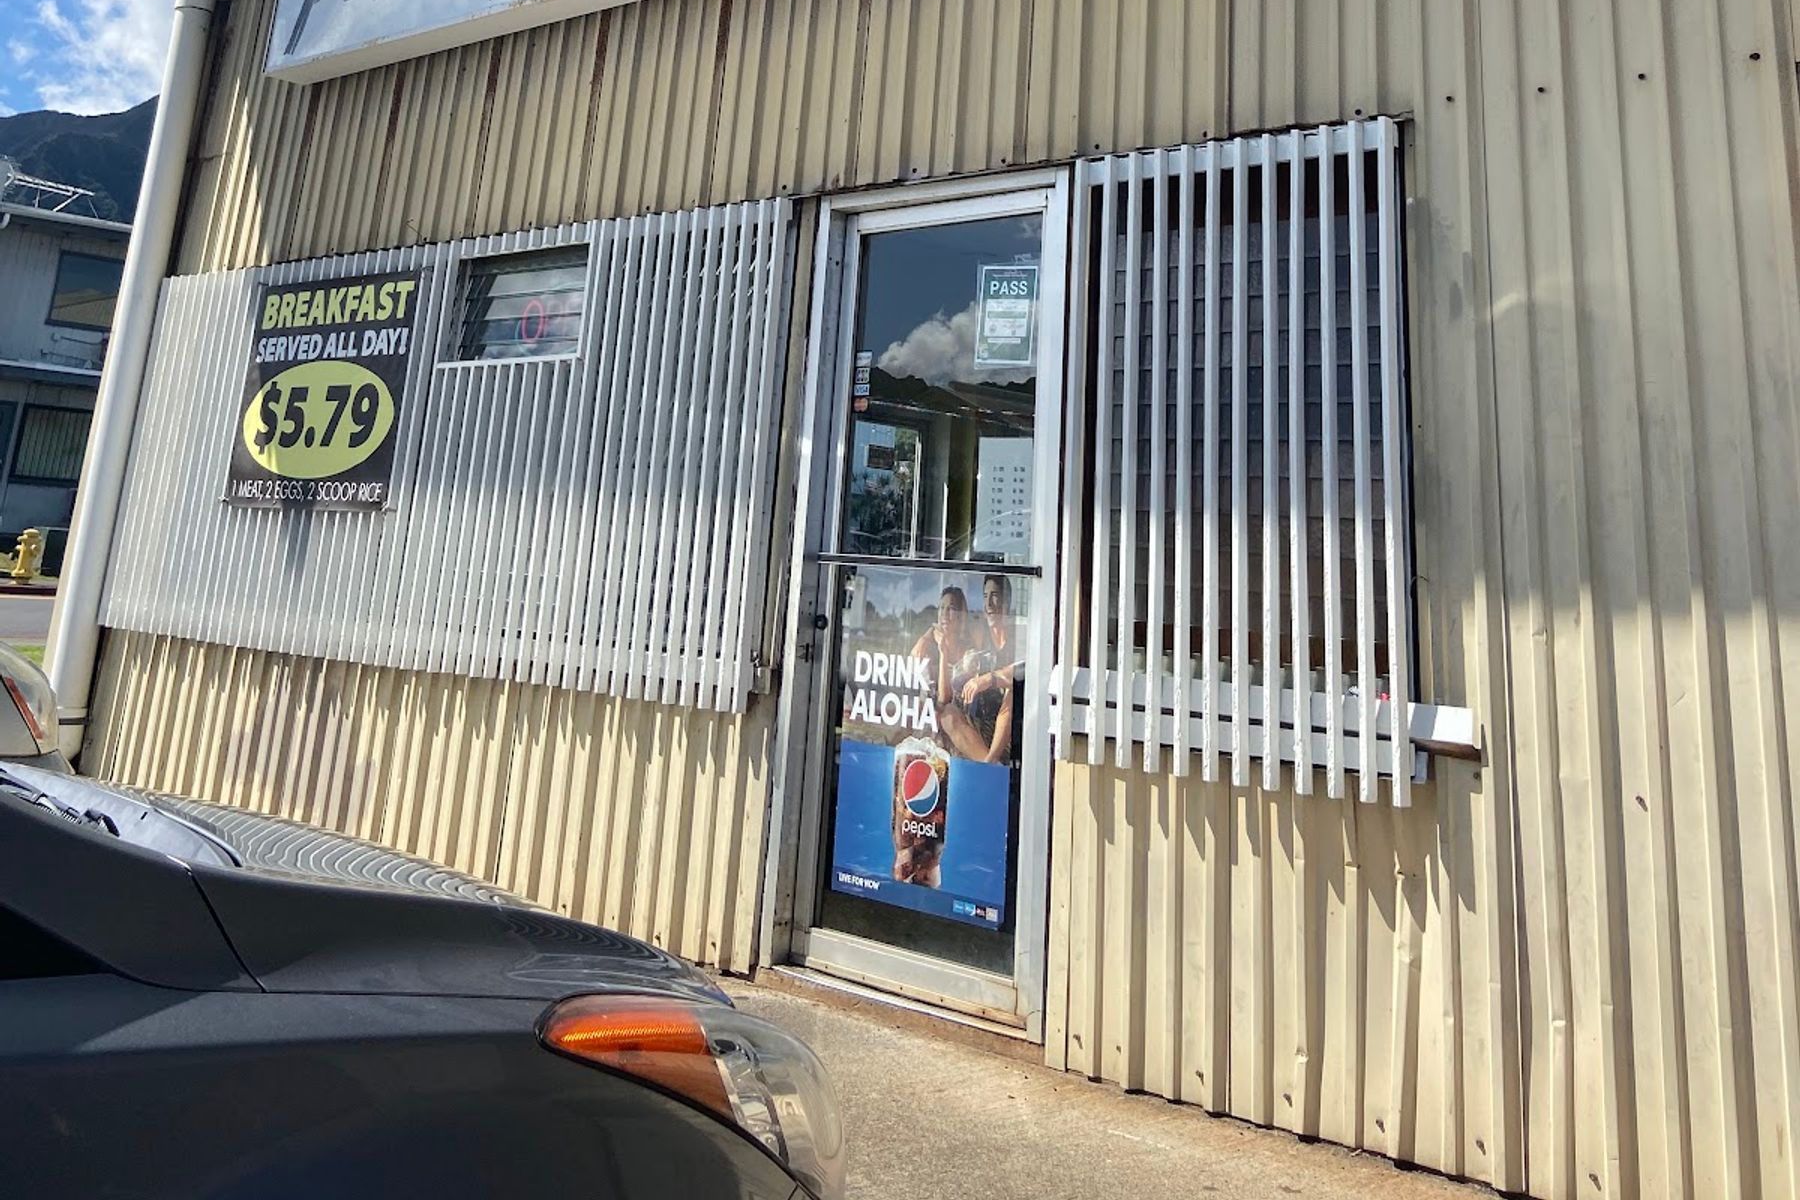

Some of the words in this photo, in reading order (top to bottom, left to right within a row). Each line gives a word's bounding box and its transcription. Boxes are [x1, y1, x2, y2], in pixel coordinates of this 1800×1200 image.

[261, 280, 416, 330] BREAKFAST
[990, 280, 1028, 295] PASS
[256, 336, 323, 363] SERVED
[324, 331, 359, 357] ALL
[362, 327, 410, 356] DAY!
[254, 381, 380, 455] $5.79
[232, 479, 237, 496] 1
[238, 480, 263, 501] MEAT,
[265, 480, 273, 498] 2
[274, 480, 305, 502] EGGS,
[307, 481, 316, 499] 2
[316, 481, 357, 501] SCOOP
[357, 483, 383, 502] RICE
[853, 650, 931, 692] DRINK
[849, 688, 939, 734] ALOHA
[901, 818, 936, 838] pepsi
